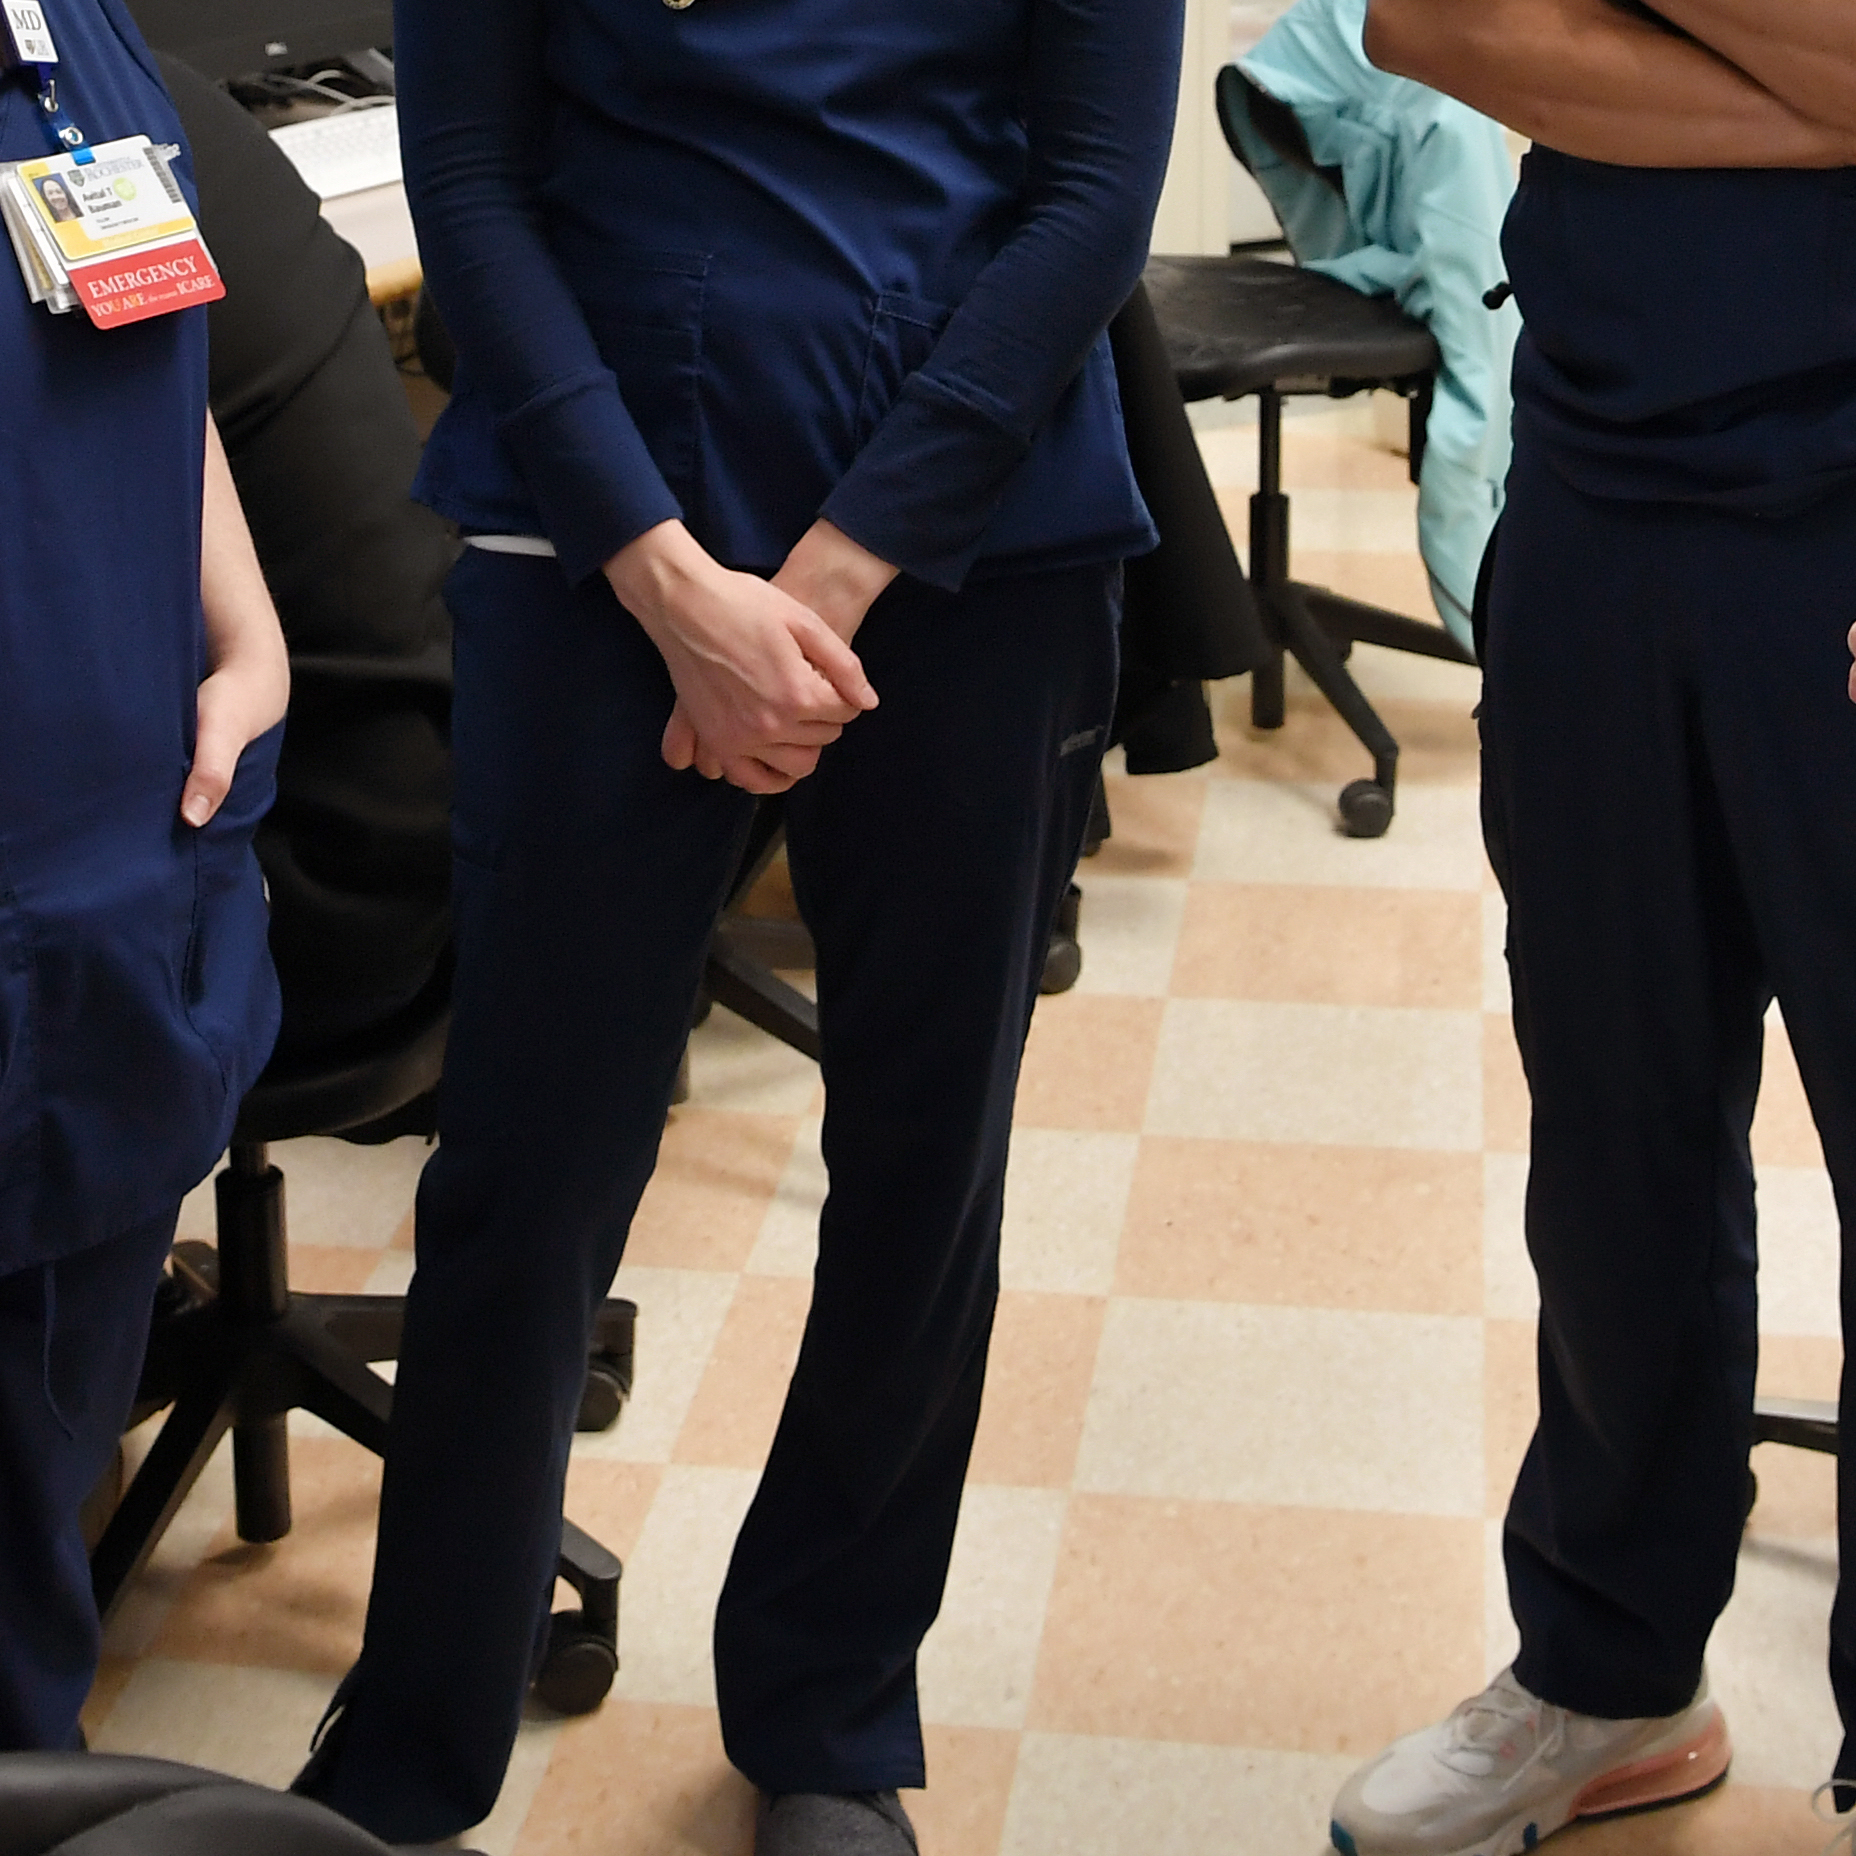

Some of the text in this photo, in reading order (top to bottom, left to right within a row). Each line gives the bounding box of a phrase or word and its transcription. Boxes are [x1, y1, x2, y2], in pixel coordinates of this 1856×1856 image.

[12, 8, 42, 31] MD
[87, 255, 198, 299] EMERGENCY
[91, 298, 122, 317] YOU
[123, 292, 147, 310] ARE
